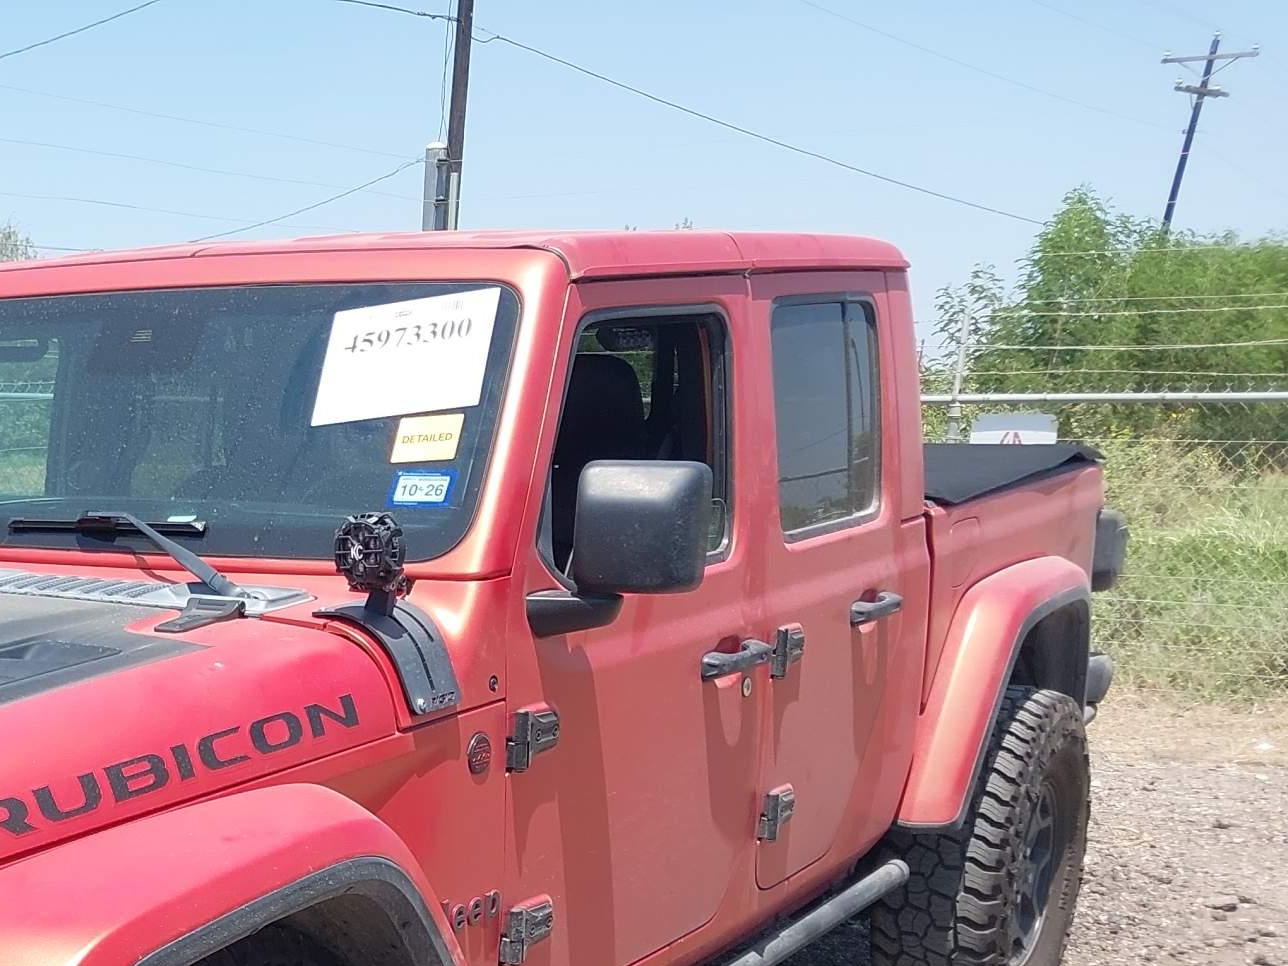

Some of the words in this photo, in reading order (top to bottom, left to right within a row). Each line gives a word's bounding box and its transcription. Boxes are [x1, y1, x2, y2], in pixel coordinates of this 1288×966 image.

[344, 317, 473, 354] 45973300
[401, 432, 453, 445] DETAILED
[350, 543, 364, 561] KC
